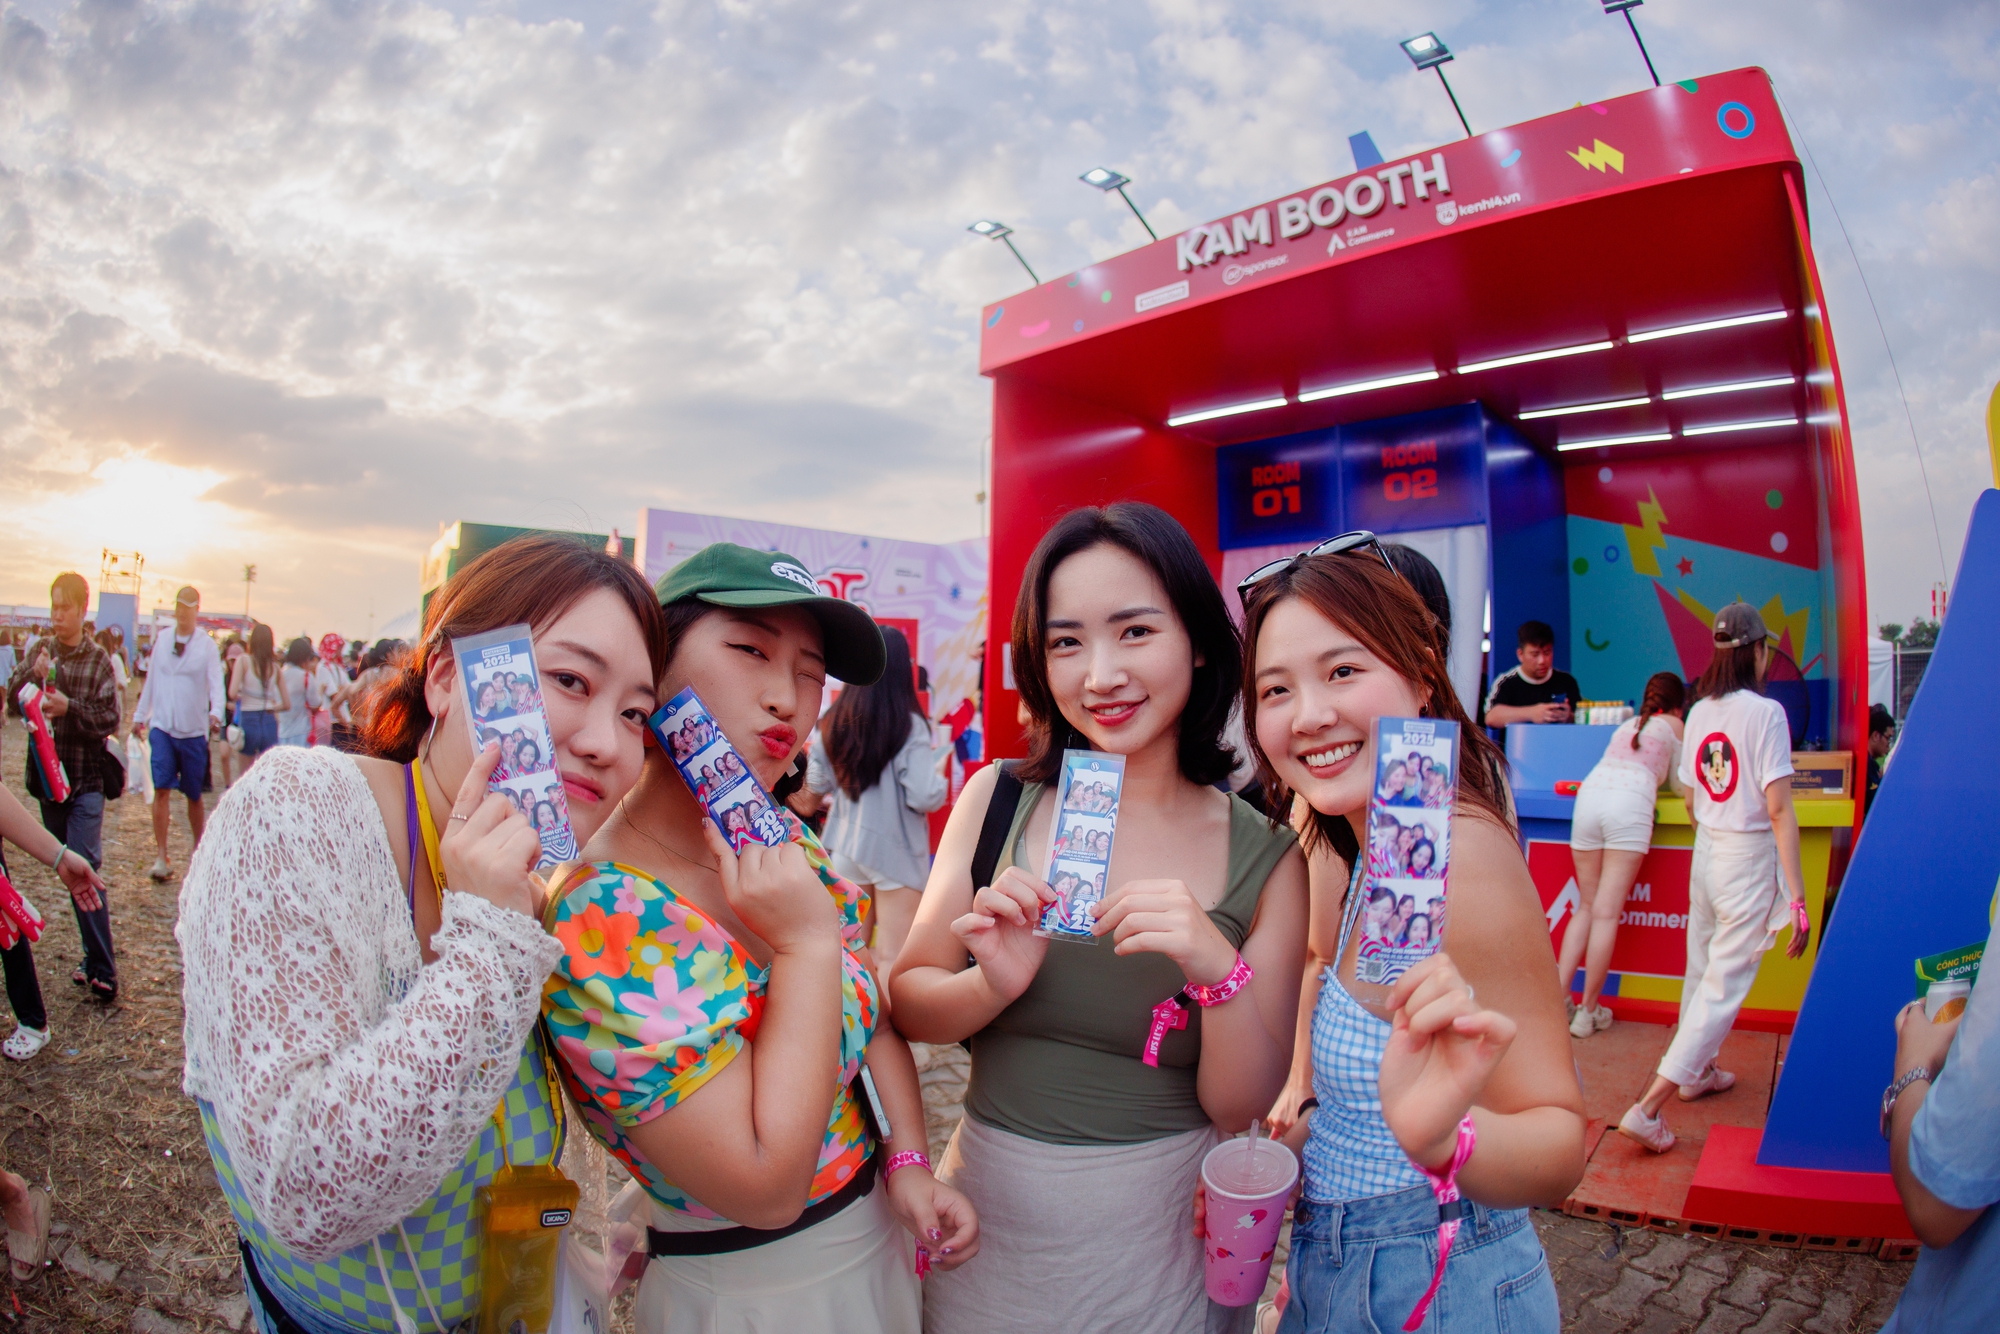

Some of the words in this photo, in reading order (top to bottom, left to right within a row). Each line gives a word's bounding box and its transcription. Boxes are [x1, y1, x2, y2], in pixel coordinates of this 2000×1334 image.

[1176, 208, 1271, 272] KAM
[1277, 152, 1450, 240] BOOTH
[1347, 228, 1395, 247] Commerce
[1381, 440, 1437, 468] ROOM
[1252, 461, 1300, 487] ROOM
[1383, 468, 1438, 501] 02
[1253, 485, 1301, 517] 01
[484, 655, 512, 668] 2025
[1403, 733, 1435, 746] 2025
[755, 810, 776, 834] 20
[763, 823, 785, 847] 25
[1069, 915, 1096, 930] 25
[1619, 911, 1689, 929] ommer
[1936, 957, 1960, 971] CÔNG
[1947, 964, 1971, 977] NGON
[1206, 984, 1232, 1002] SAT
[1153, 1020, 1164, 1041] 15.11
[1150, 1041, 1158, 1056] SAT
